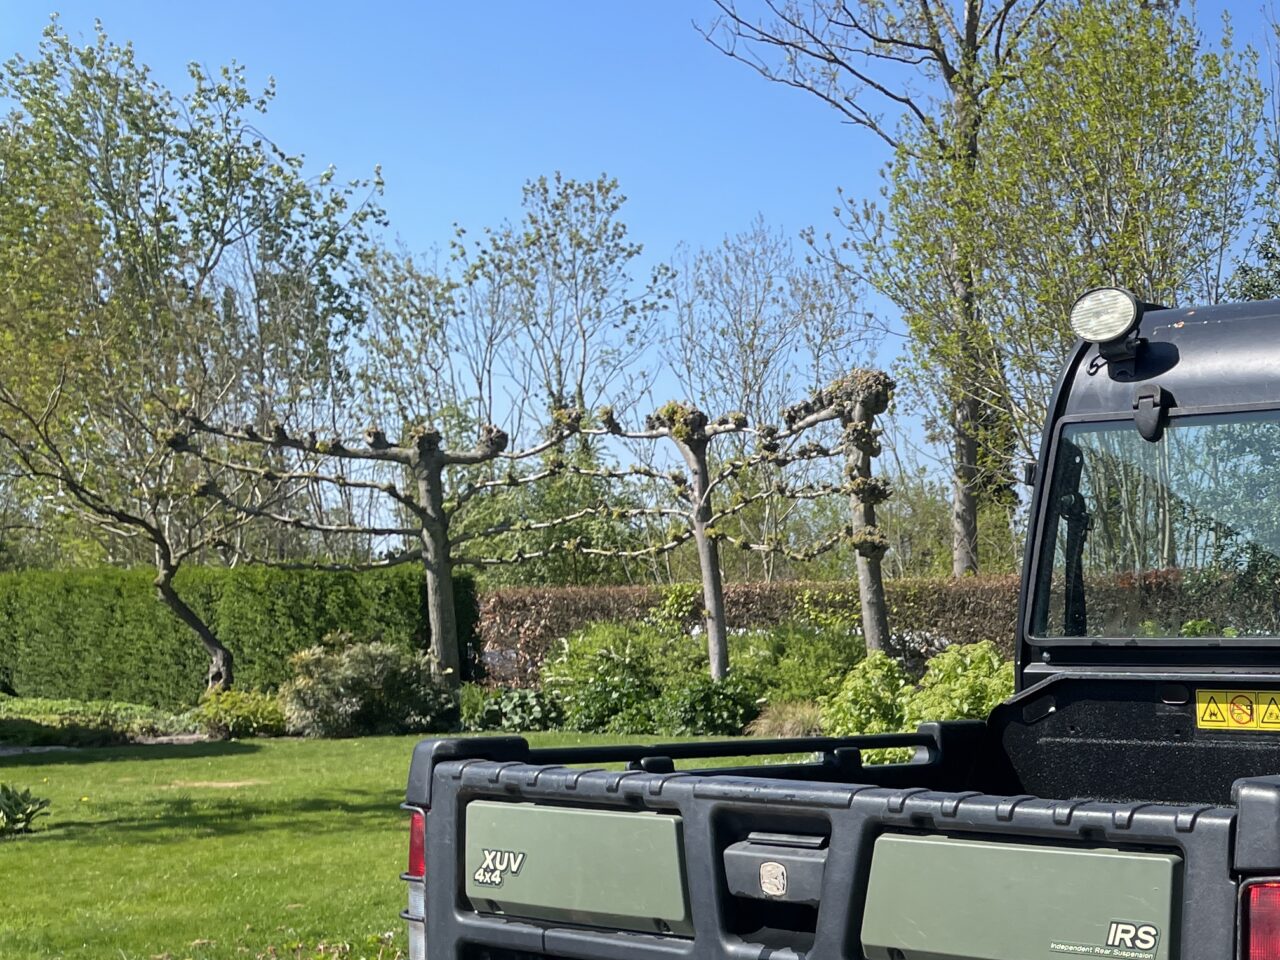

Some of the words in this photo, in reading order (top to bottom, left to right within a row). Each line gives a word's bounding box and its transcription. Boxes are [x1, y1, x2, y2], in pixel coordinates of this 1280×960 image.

[482, 850, 524, 872] XUV
[474, 868, 502, 884] 4x4
[1107, 923, 1157, 950] IRS
[1050, 942, 1093, 953] Independent
[1094, 947, 1112, 955] Rear
[1113, 948, 1154, 960] Suspension
